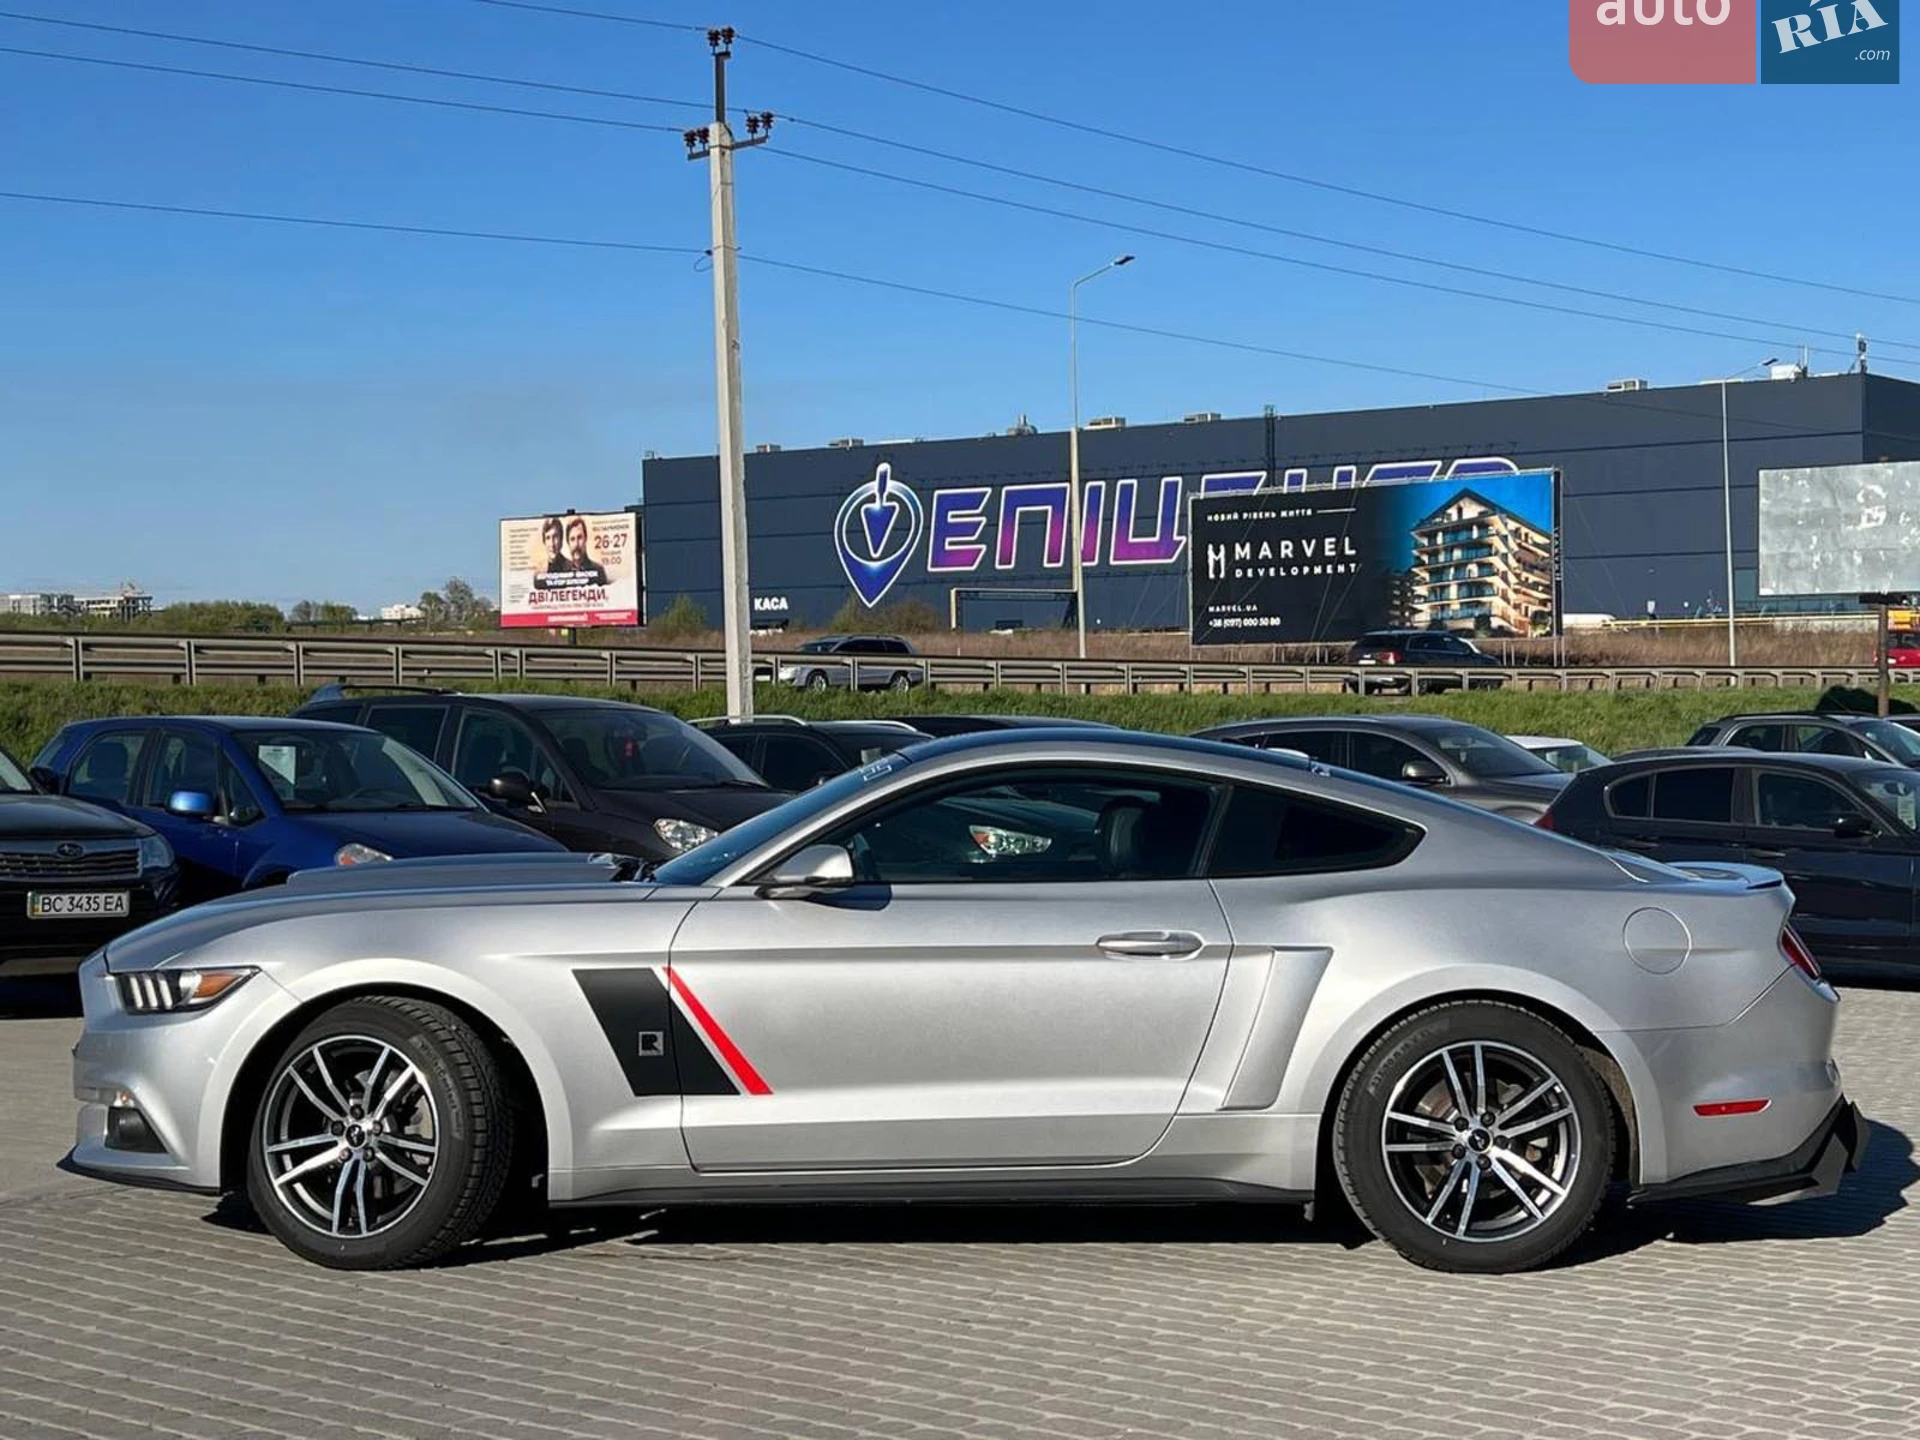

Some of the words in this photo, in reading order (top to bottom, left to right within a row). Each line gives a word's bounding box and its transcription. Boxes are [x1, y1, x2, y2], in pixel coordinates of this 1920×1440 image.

[1242, 510, 1277, 520] РІВЕНЬ
[1234, 536, 1357, 561] MARVEL
[1235, 563, 1357, 578] DEVELOPMENT
[528, 591, 549, 605] ДВІ
[754, 596, 789, 611] КАСА
[41, 896, 64, 913] BC
[67, 895, 100, 912] 3435
[103, 895, 124, 911] EA
